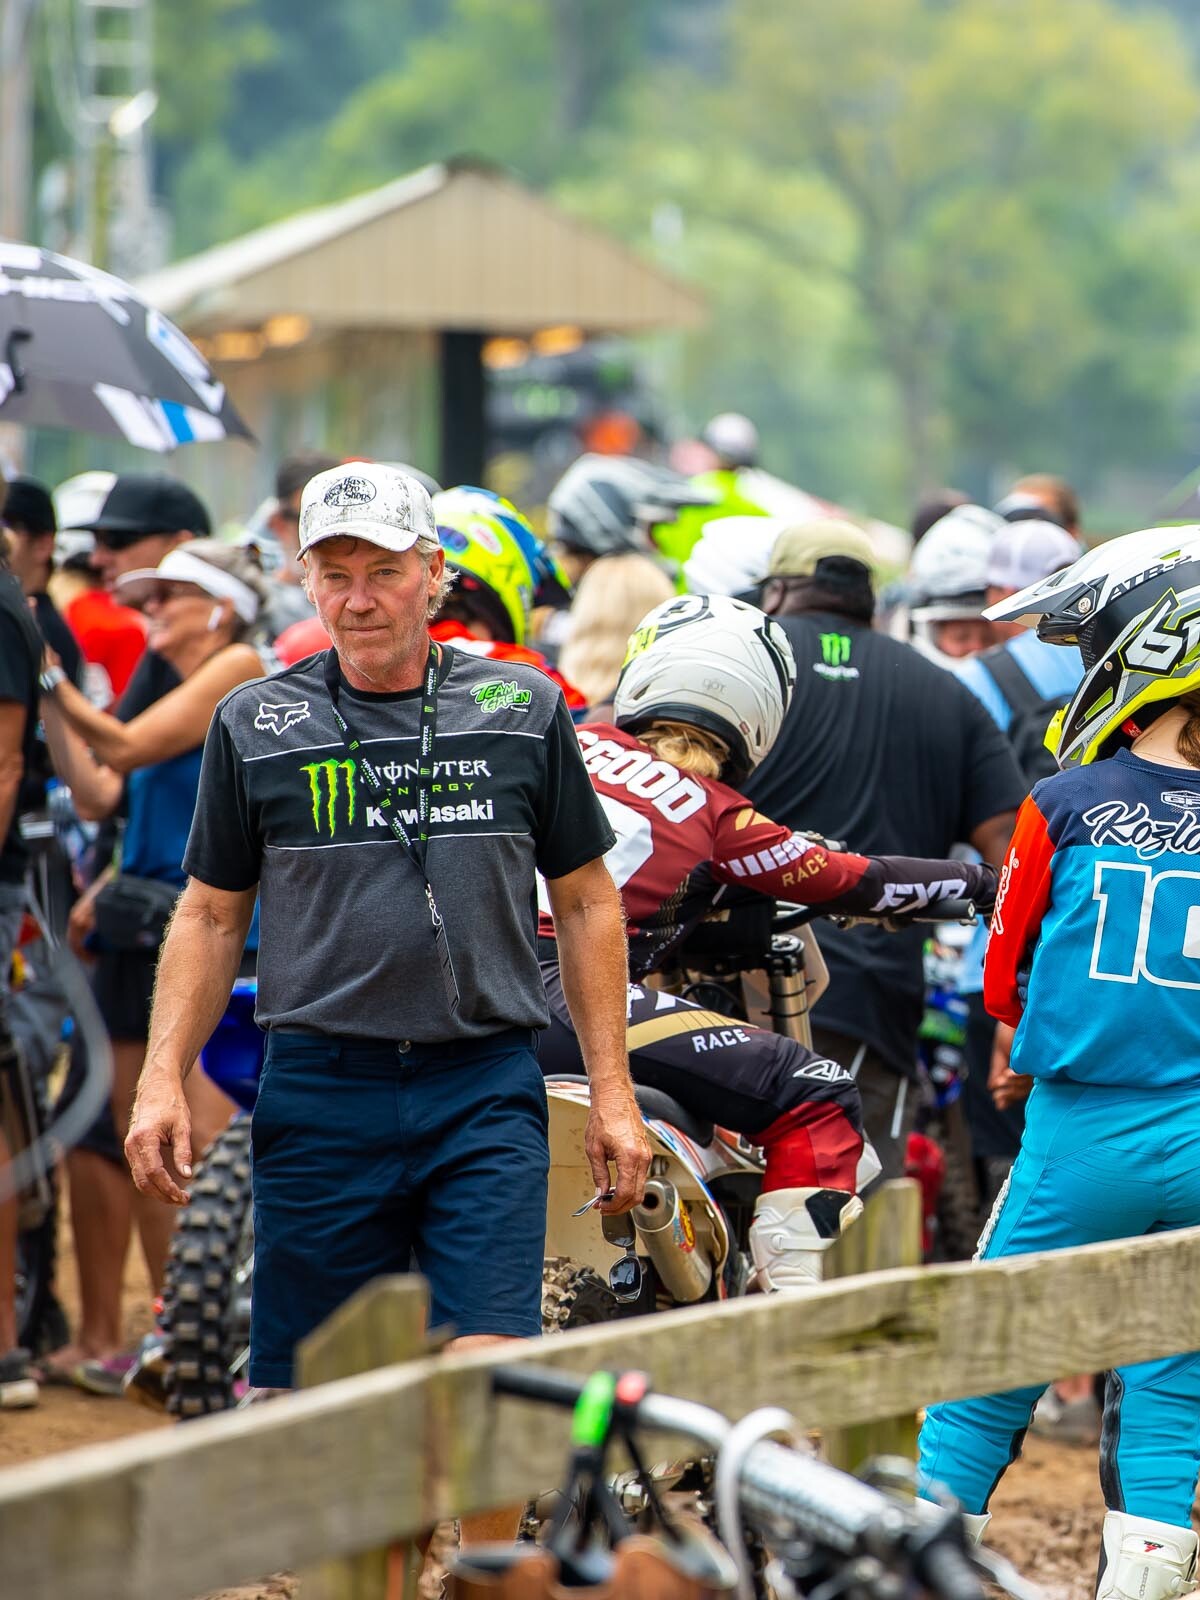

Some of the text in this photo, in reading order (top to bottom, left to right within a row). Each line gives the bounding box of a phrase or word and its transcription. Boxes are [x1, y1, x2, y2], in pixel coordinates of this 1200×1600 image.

[471, 681, 517, 703] TEAM
[481, 690, 531, 712] GREEN
[366, 800, 494, 828] Kwasaki
[781, 853, 829, 888] RACE
[691, 1028, 751, 1053] RACE
